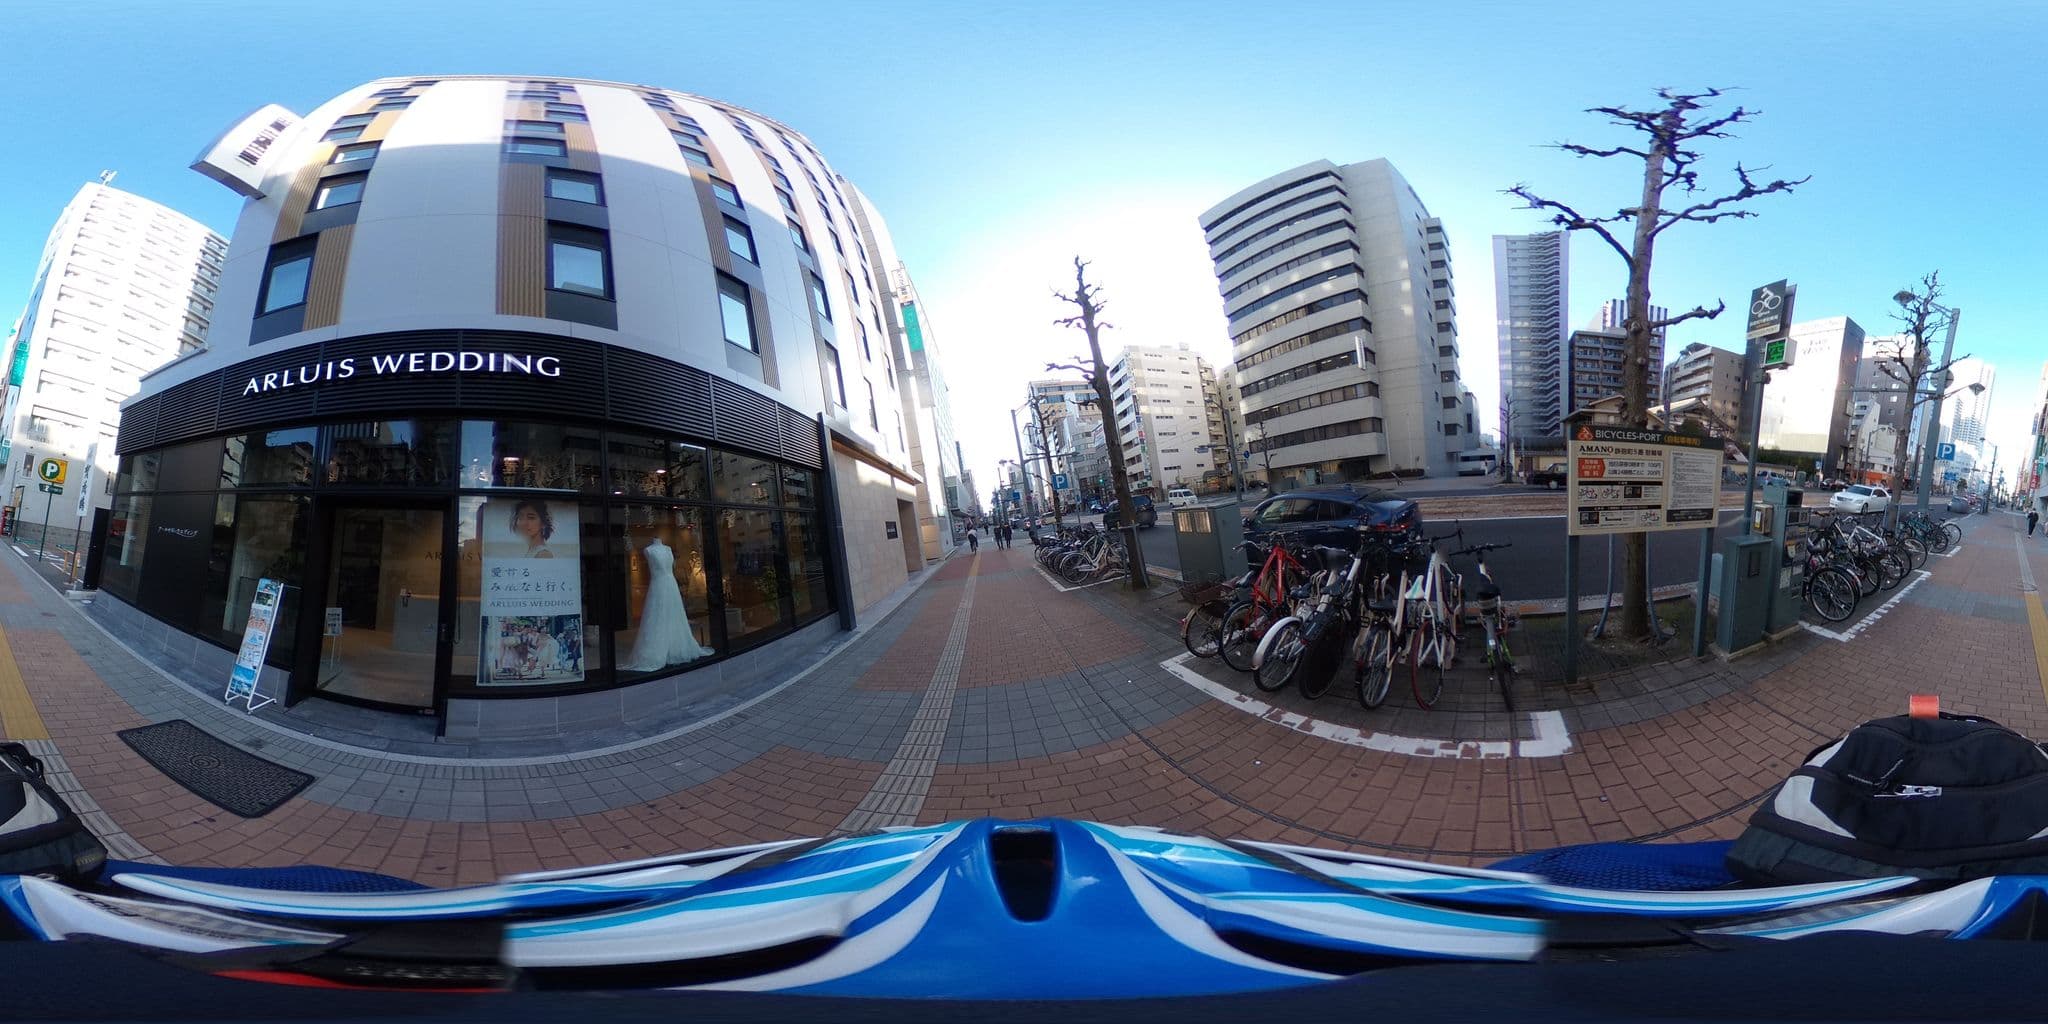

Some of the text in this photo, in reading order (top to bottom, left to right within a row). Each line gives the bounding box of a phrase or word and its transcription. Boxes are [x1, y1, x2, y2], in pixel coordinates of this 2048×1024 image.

[243, 351, 561, 396] ARLUIS WEDDING
[1595, 429, 1662, 442] BICYCLES-PORT
[1579, 445, 1614, 453] AMANO
[1942, 445, 1952, 458] P
[46, 462, 58, 477] P
[1056, 476, 1065, 488] P
[530, 599, 574, 608] WEDDING
